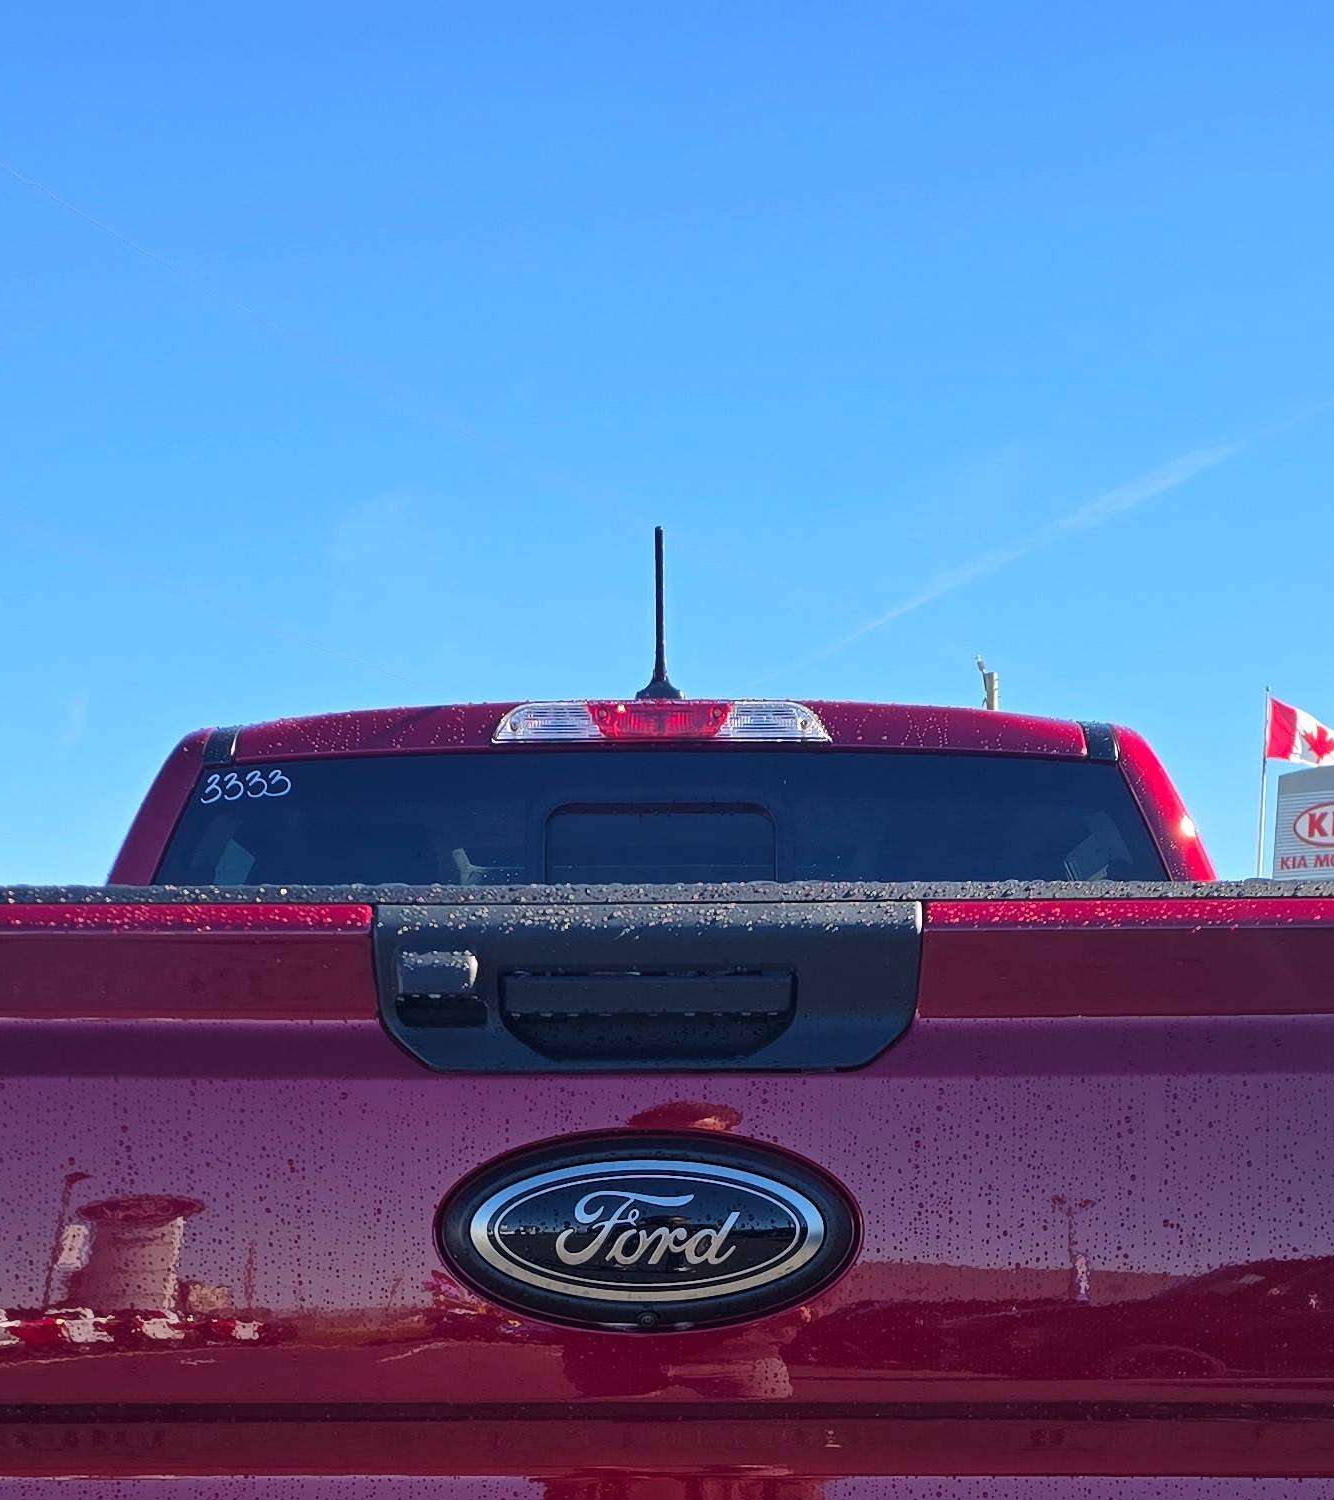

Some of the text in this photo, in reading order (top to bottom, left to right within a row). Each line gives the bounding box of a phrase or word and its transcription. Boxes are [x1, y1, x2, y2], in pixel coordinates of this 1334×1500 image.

[200, 769, 292, 804] 3333
[1280, 855, 1308, 871] KIA
[555, 1190, 741, 1265] Ford
